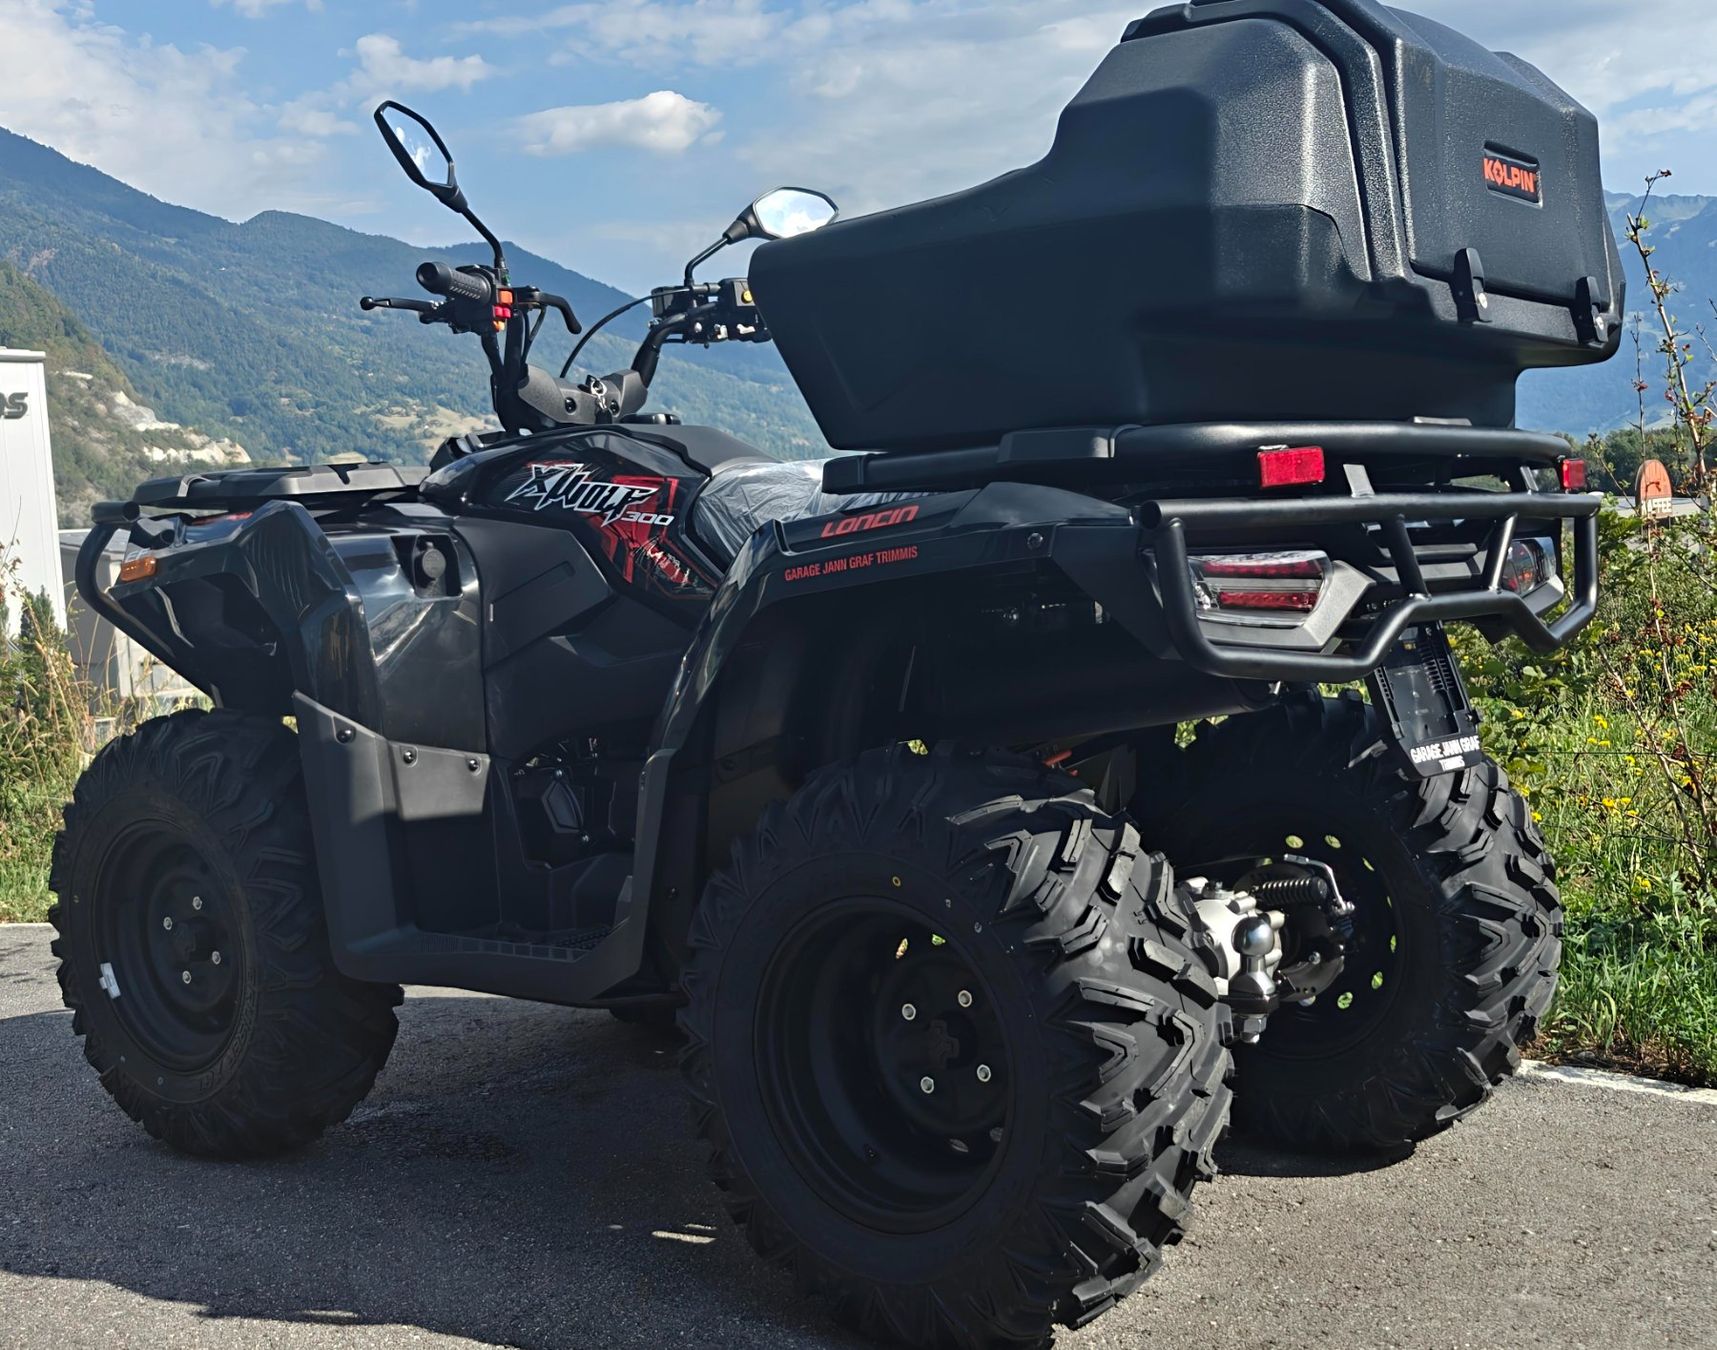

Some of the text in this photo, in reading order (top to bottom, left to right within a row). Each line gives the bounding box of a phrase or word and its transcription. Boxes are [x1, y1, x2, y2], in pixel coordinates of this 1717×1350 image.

[1483, 158, 1535, 193] KOLPIN
[620, 511, 675, 526] 300
[820, 505, 920, 538] LONCIN
[784, 546, 918, 581] GARAGE JANN GRAF TRIMMIS
[1410, 743, 1443, 764] GARAGE
[1460, 735, 1480, 752] GRAF
